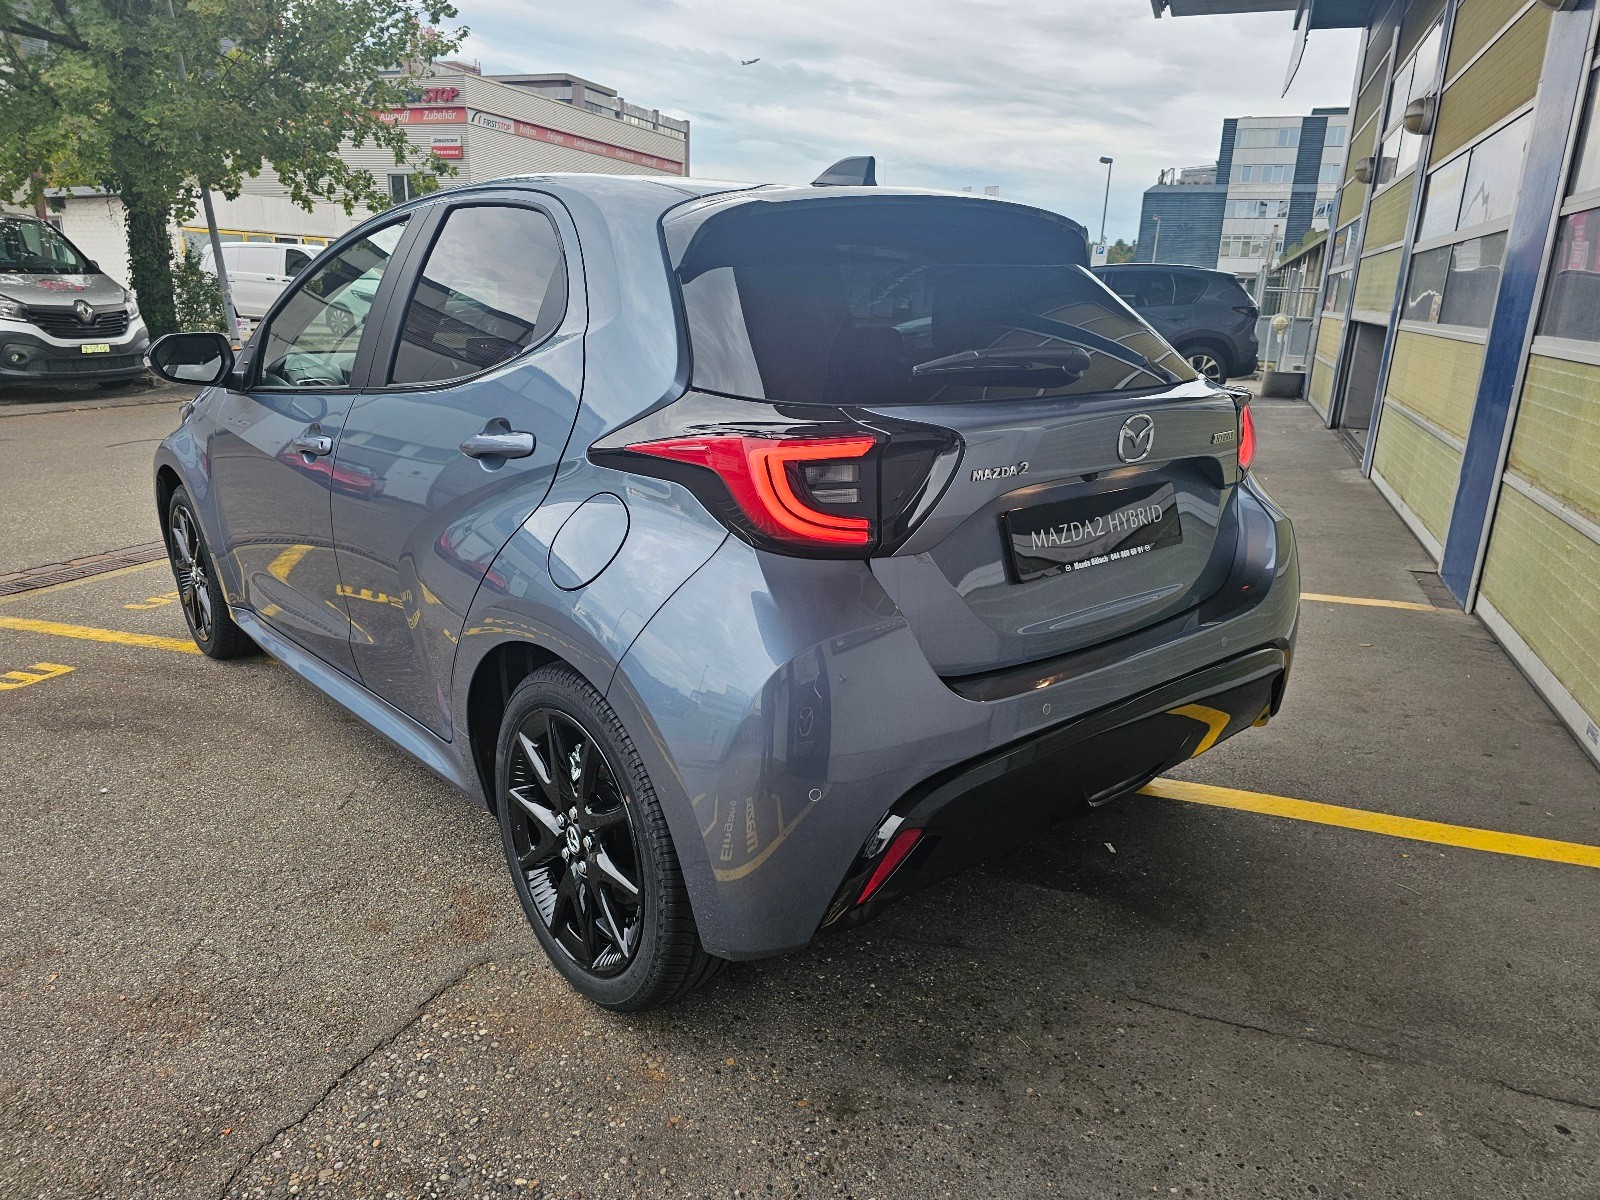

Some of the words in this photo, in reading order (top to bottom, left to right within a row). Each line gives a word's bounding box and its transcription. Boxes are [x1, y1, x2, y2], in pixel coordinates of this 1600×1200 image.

[423, 110, 457, 120] Zubehör
[519, 124, 537, 136] Reifen
[547, 131, 564, 143] Felgen
[1031, 516, 1106, 550] MAZDA2
[1108, 504, 1163, 533] HYBRID
